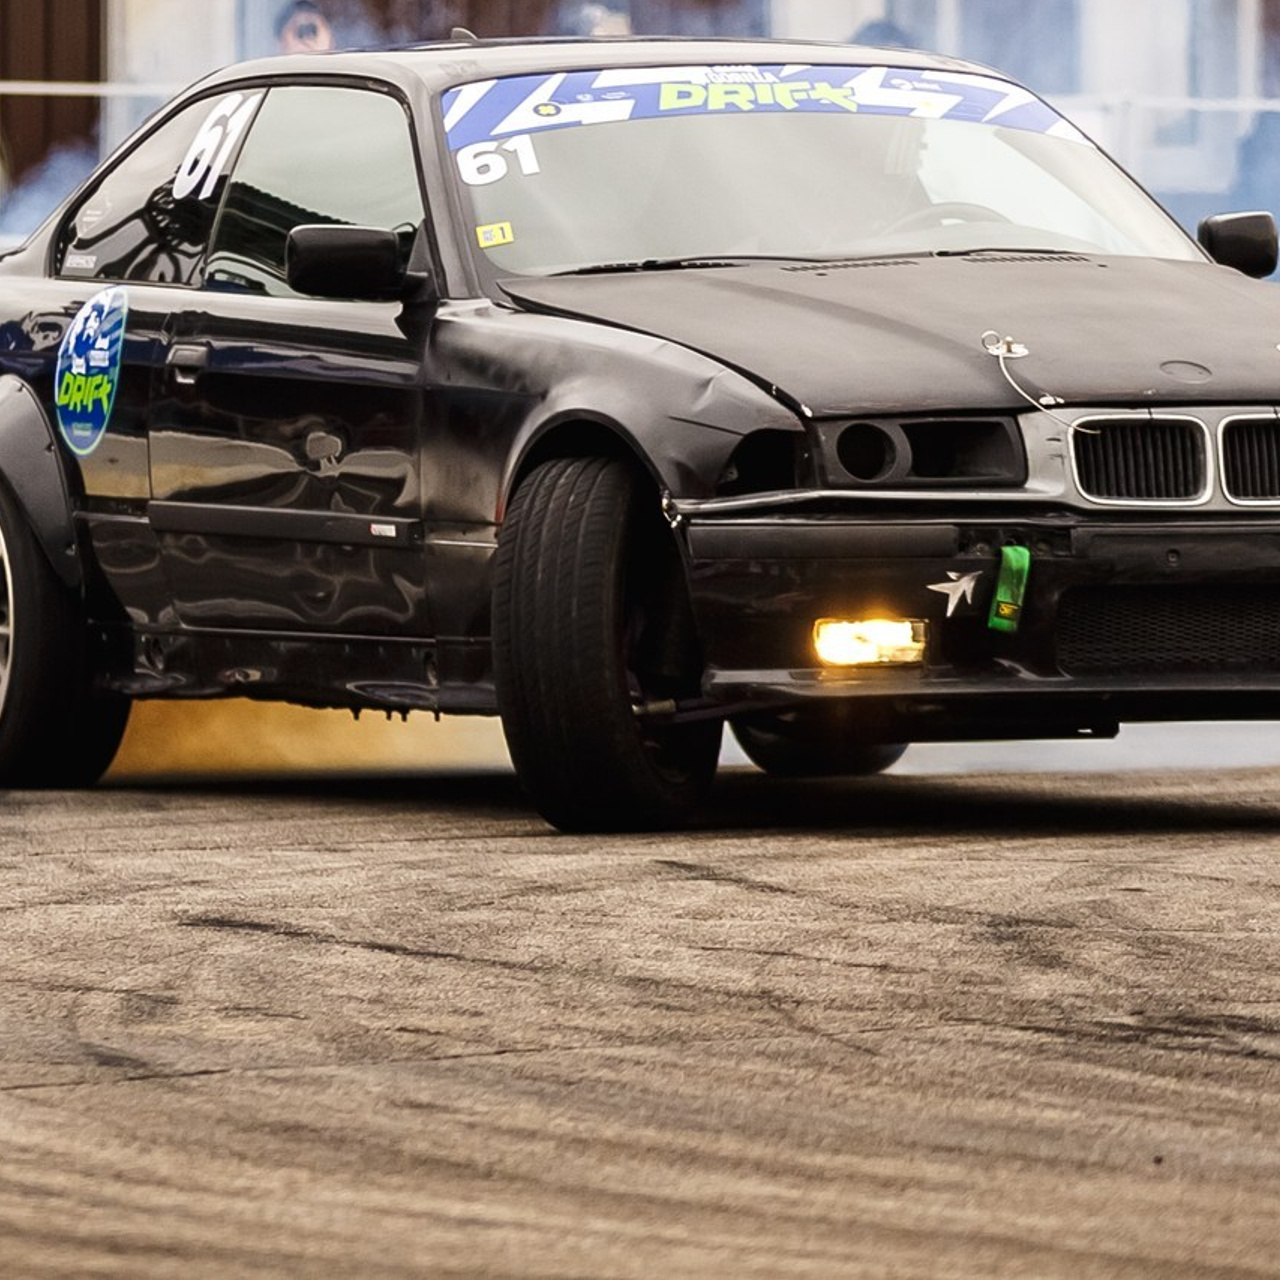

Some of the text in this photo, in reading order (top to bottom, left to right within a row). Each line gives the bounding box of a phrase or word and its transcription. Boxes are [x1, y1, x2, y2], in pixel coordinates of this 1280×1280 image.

[659, 81, 858, 113] DRIFT
[172, 92, 264, 201] 61
[456, 134, 541, 187] 61
[58, 371, 112, 416] DRIFT
